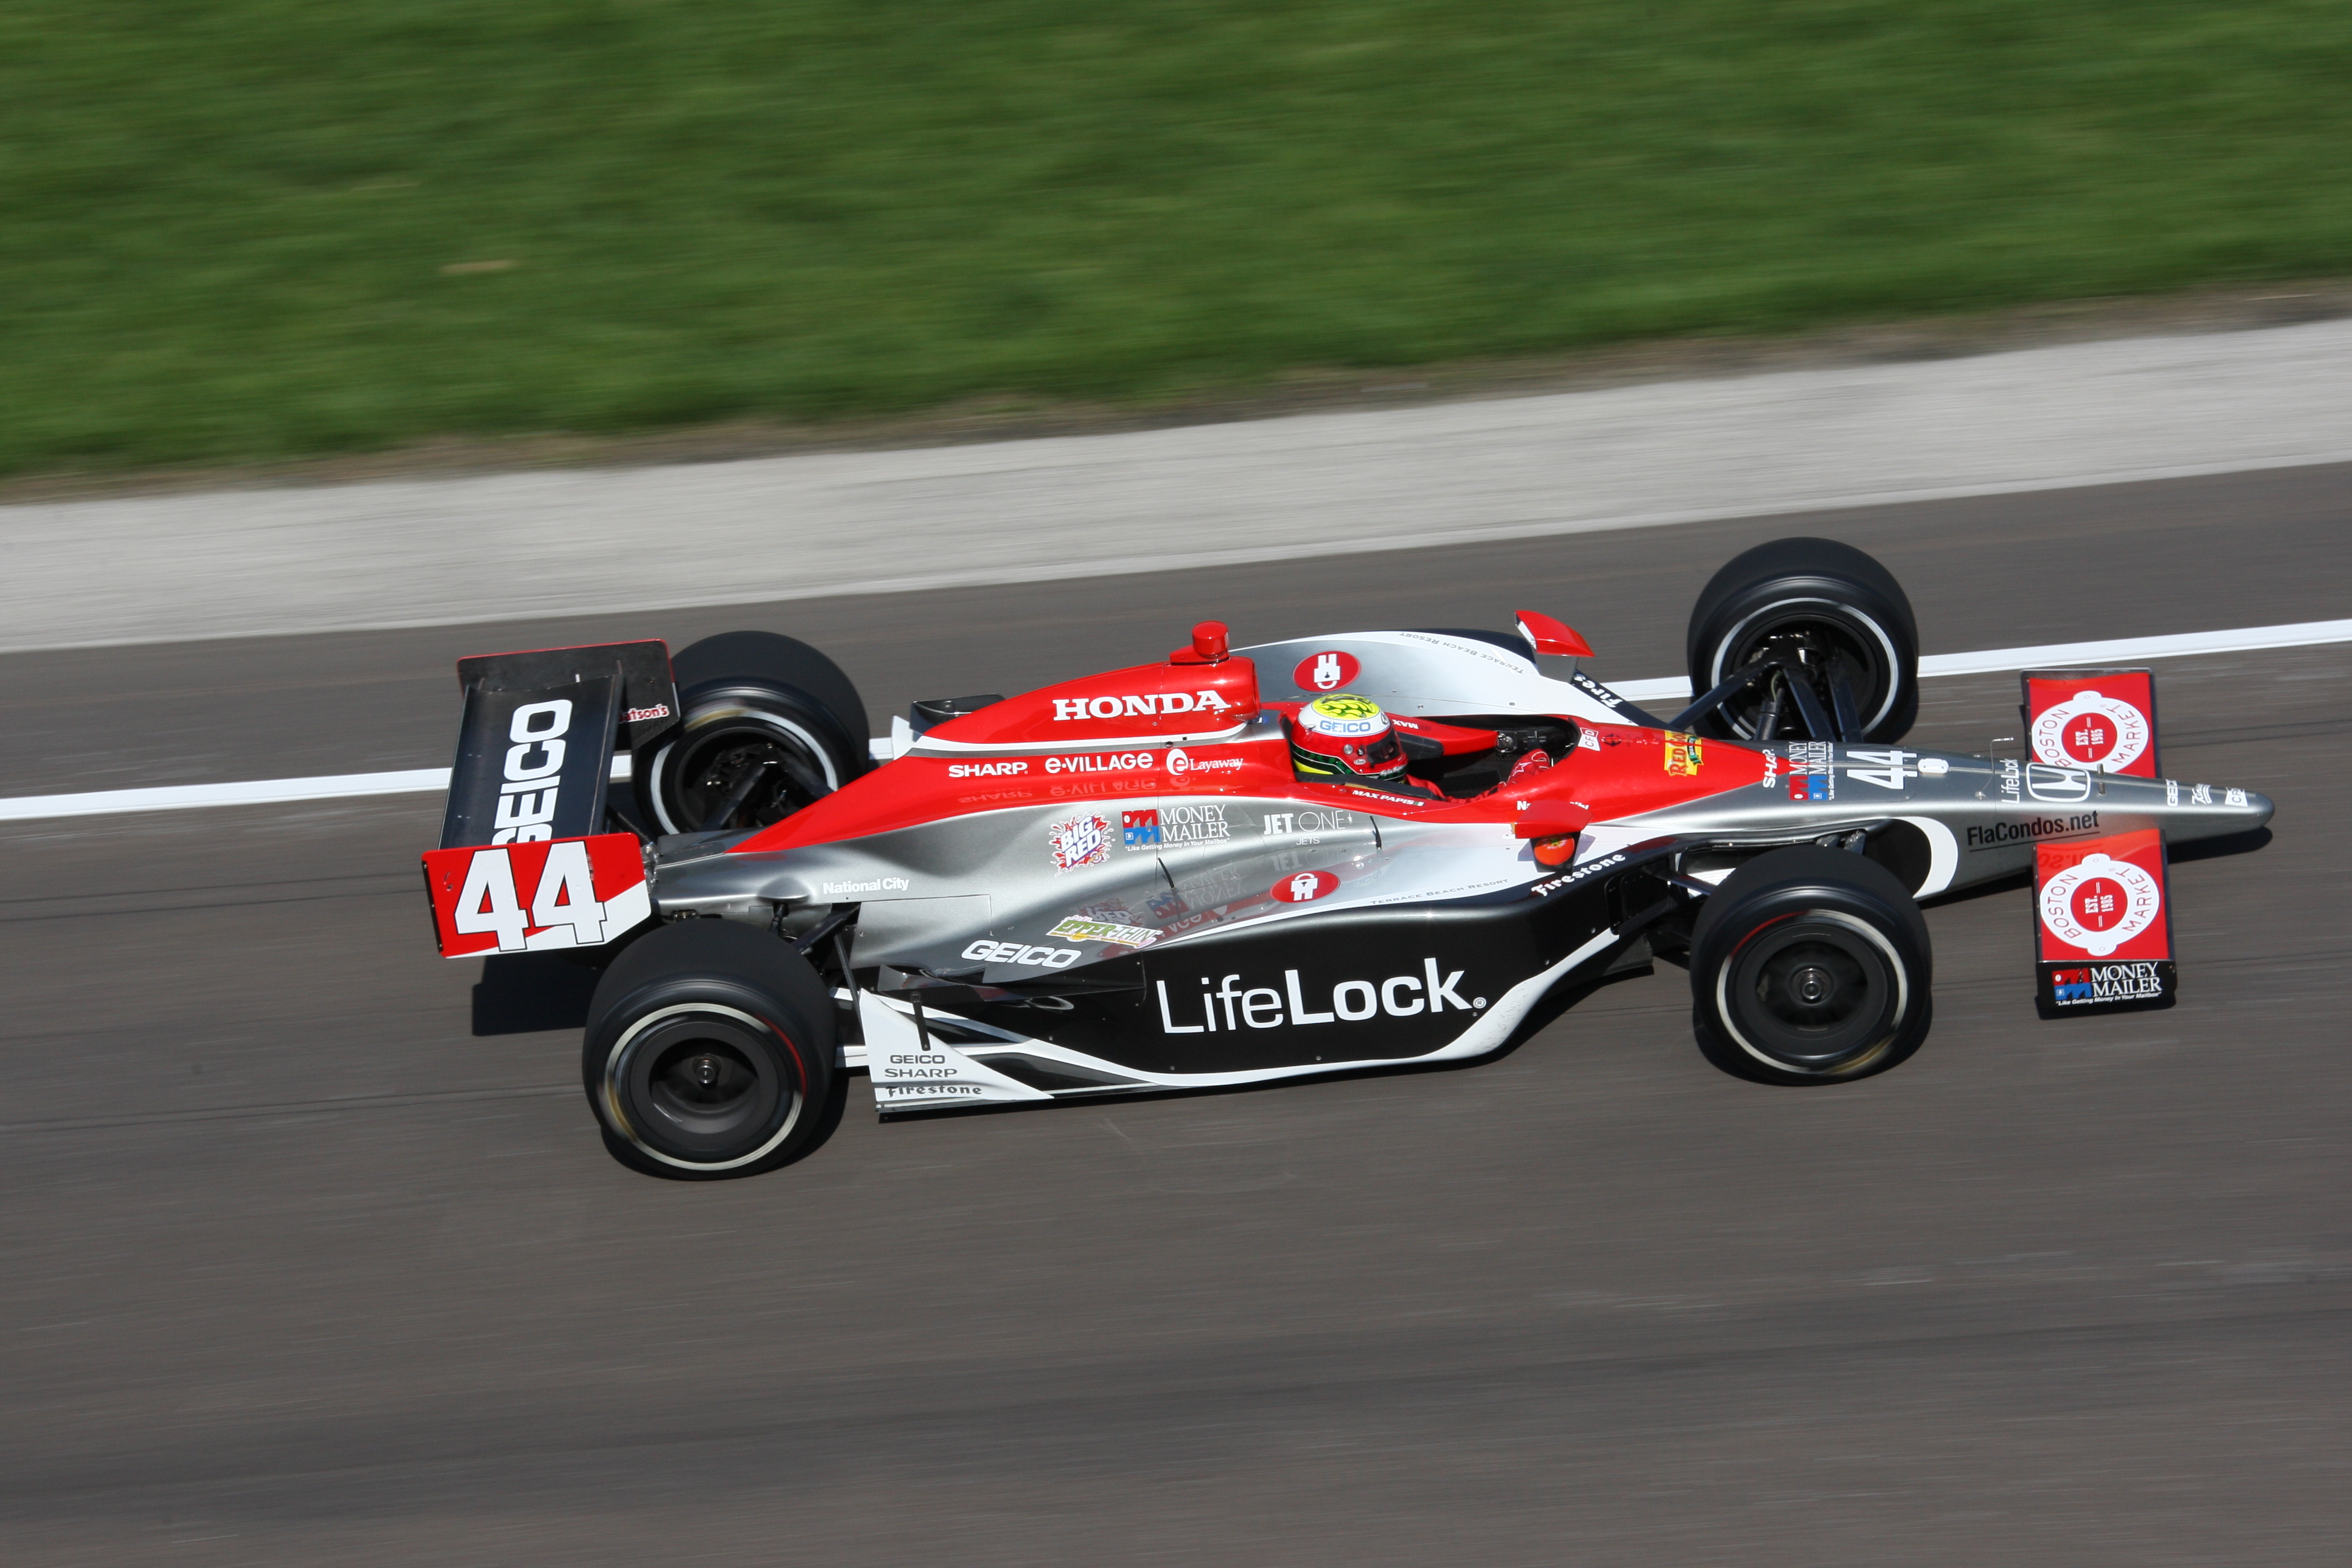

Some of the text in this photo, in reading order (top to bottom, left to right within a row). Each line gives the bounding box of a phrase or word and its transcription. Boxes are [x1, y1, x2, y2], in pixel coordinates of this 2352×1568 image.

[1399, 632, 1524, 674] TERRACE BEACH RESORT
[1052, 690, 1232, 721] HONDA
[1319, 720, 1371, 733] GEICO
[1391, 719, 1419, 730] MAX
[2106, 704, 2141, 763] MARKET
[1584, 730, 1596, 748] CFD
[2039, 709, 2073, 768] BOSTON
[948, 761, 1027, 778] SHARP
[1669, 748, 1688, 777] RED
[1789, 741, 1808, 775] MONEY
[1808, 741, 1827, 775] MAILER
[1846, 750, 1918, 789] 44
[1999, 758, 2020, 804] LifeLock
[1352, 789, 1415, 805] MAX PAPIS
[1159, 804, 1226, 825] MONEY
[1264, 810, 1346, 835] JET ONE
[1967, 809, 2100, 846] FlaCondos.net
[1060, 816, 1094, 853] BIG
[1160, 822, 1230, 842] MAILER
[1296, 837, 1320, 846] JETS
[1065, 829, 1102, 867] RED
[823, 877, 910, 894] National City
[1531, 853, 1625, 897] Firestone
[454, 841, 607, 952] 44
[1370, 879, 1508, 905] TERRACE BEACH RESORT
[2084, 895, 2099, 914] EST.
[2100, 894, 2114, 913] 1985
[2115, 867, 2152, 932] MARKET
[2047, 874, 2082, 939] BOSTON
[961, 939, 1083, 969] GEICO
[2089, 961, 2158, 982] MONEY
[1156, 957, 1473, 1033] LifeLock
[2091, 976, 2163, 998] MAILER
[890, 1054, 946, 1064] GEICO
[884, 1068, 958, 1078] SHARP
[885, 1085, 982, 1098] Firestone
